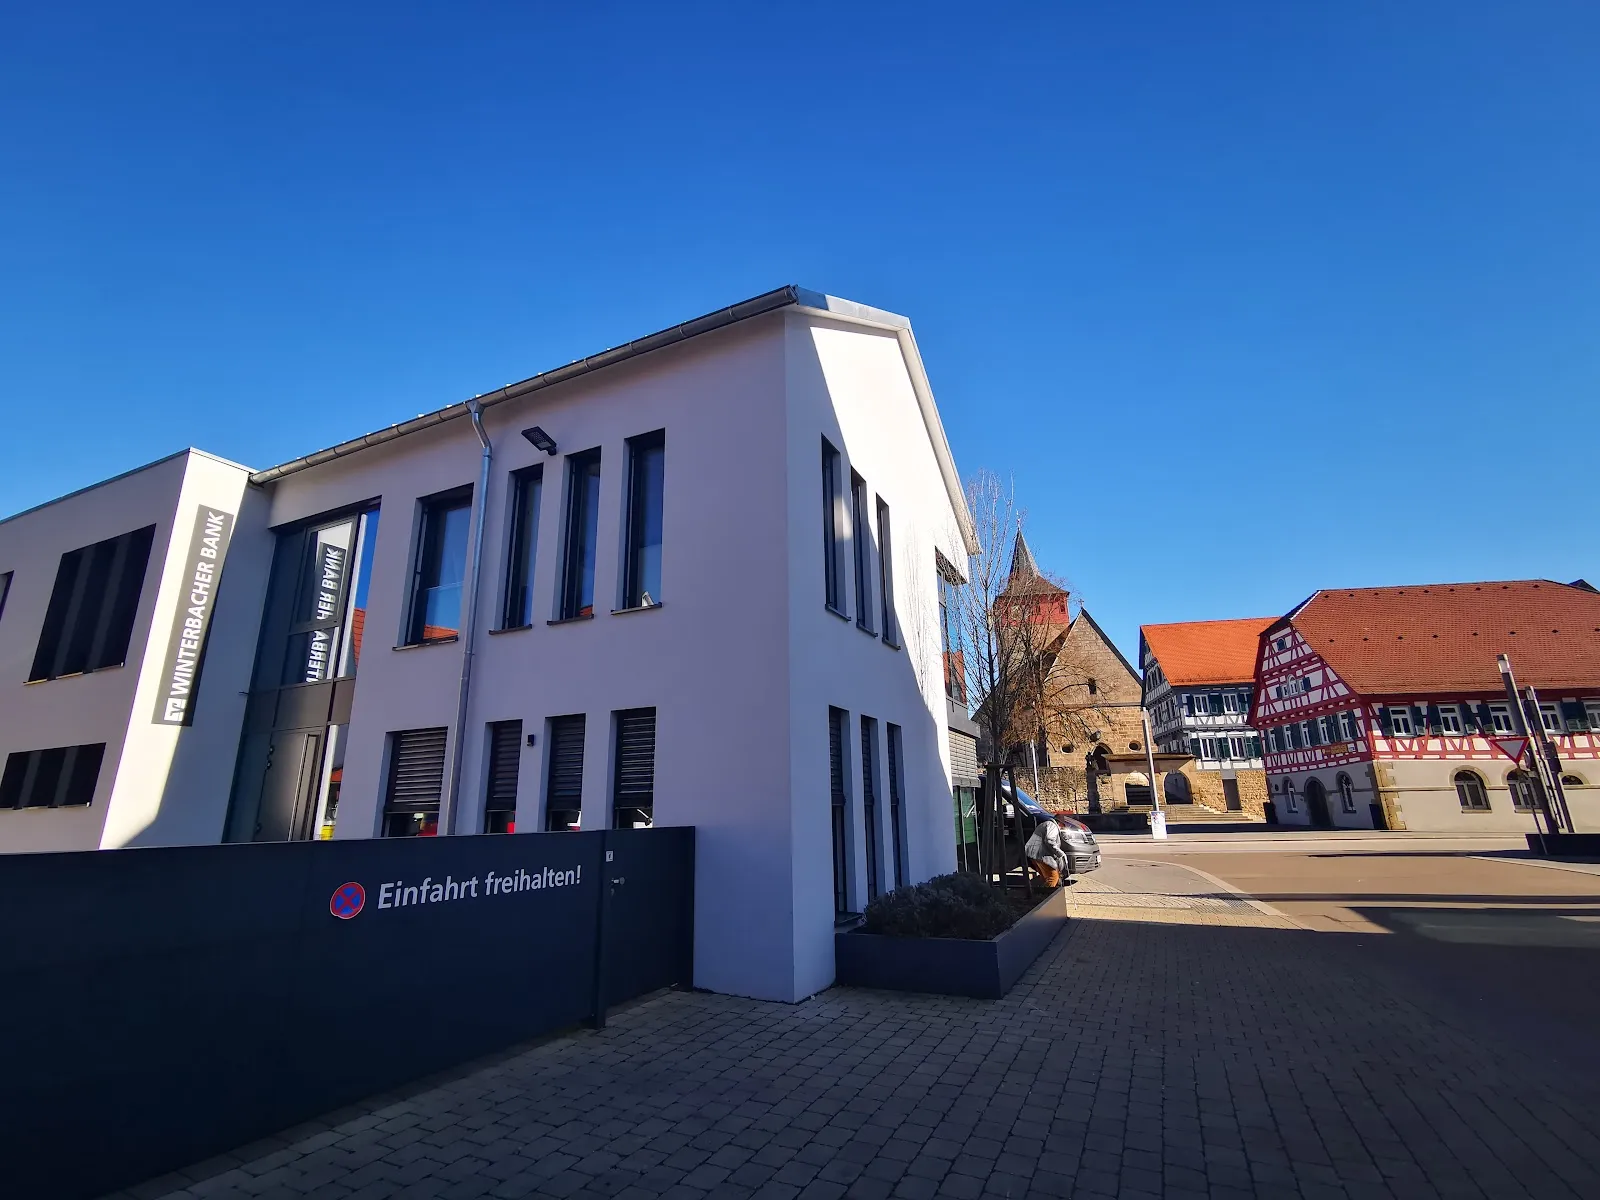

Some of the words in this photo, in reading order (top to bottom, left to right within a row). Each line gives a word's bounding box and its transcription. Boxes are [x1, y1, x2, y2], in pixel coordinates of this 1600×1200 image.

[170, 561, 214, 696] WINTERBACHER
[200, 511, 225, 560] BANK
[378, 875, 479, 909] Einfahrt
[485, 865, 581, 896] freihalten!
